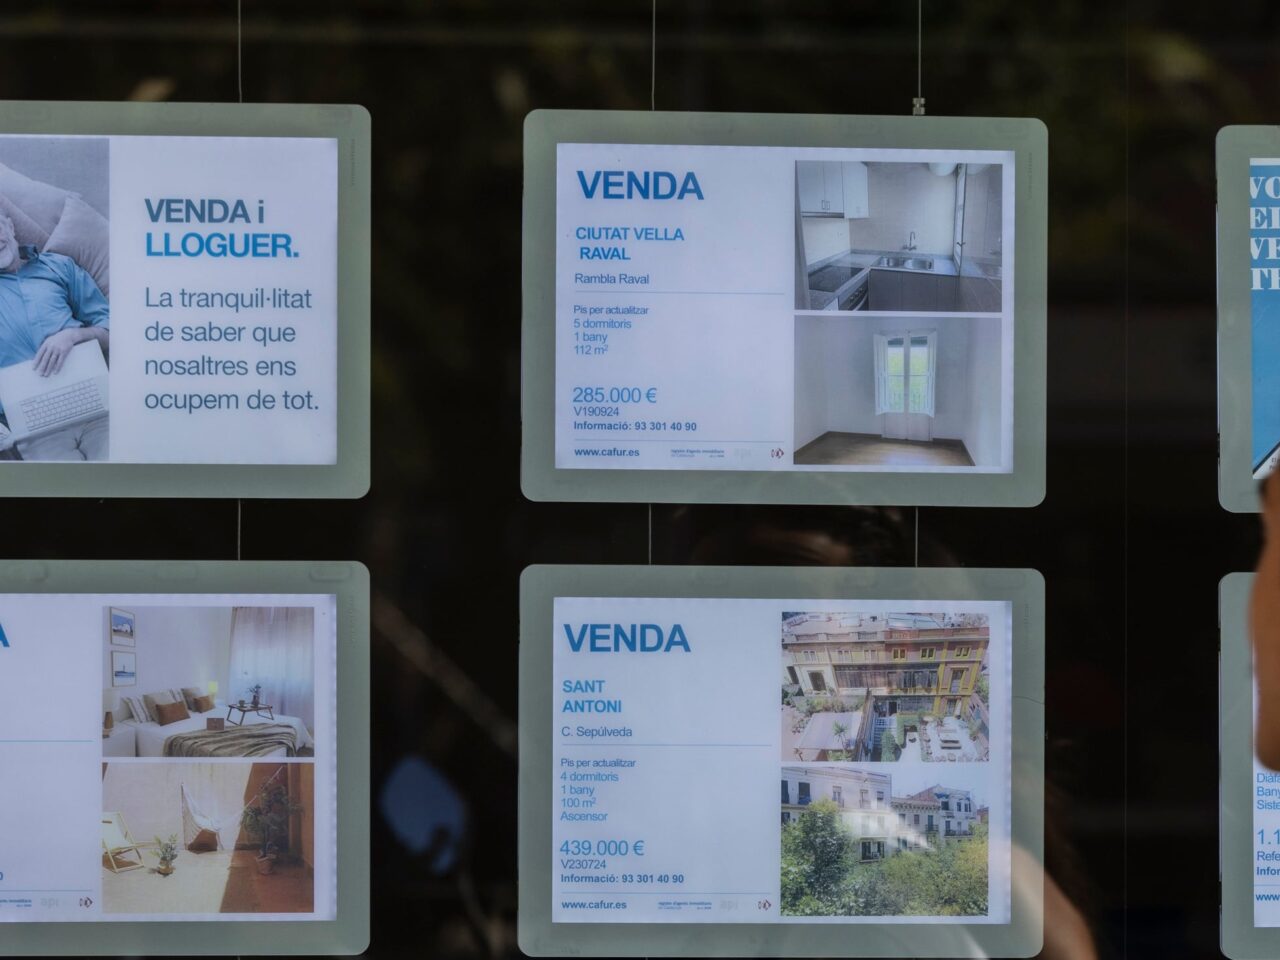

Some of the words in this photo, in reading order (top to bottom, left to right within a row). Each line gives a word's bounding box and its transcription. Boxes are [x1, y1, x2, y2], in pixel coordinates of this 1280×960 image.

[576, 171, 704, 200] VENDA
[144, 199, 251, 223] VENDA
[258, 200, 264, 223] i
[576, 227, 630, 240] CIUTAT
[634, 228, 684, 240] VELLA
[146, 232, 299, 258] LLOGUER.
[580, 247, 631, 260] RAVAL
[575, 273, 616, 283] Rambla
[619, 274, 649, 284] Raval
[146, 287, 172, 308] La
[574, 305, 587, 314] Pis
[590, 307, 604, 316] per
[606, 306, 648, 315] actualitzar
[583, 319, 631, 329] dormitoris
[145, 321, 173, 342] de
[181, 322, 246, 342] saber
[252, 326, 296, 347] que
[583, 333, 607, 343] bany
[145, 355, 248, 376] nosaltres
[256, 360, 296, 376] ens
[573, 387, 641, 403] 285.000
[646, 388, 657, 403] €
[145, 391, 239, 414] ocupem
[247, 390, 276, 410] de
[282, 391, 319, 410] tot.
[574, 407, 619, 416] V190924
[574, 421, 631, 430] Informació:
[635, 422, 646, 430] 93
[650, 422, 666, 430] 301
[670, 422, 682, 431] 40
[685, 422, 696, 431] 90
[575, 448, 639, 457] www.cafur.es
[564, 624, 691, 652] VENDA
[562, 680, 605, 693] SANT
[562, 700, 621, 713] ANTONI
[562, 727, 573, 737] C.
[577, 726, 632, 739] Sepúlveda
[560, 812, 608, 821] Ascensor
[560, 840, 629, 856] 439.000
[633, 840, 645, 856] €
[561, 859, 606, 869] V230724
[561, 874, 619, 883] Informació:
[622, 875, 633, 883] 93
[637, 875, 653, 883] 301
[658, 875, 669, 883] 40
[672, 875, 684, 883] 90
[562, 900, 626, 909] www.cafur.es
